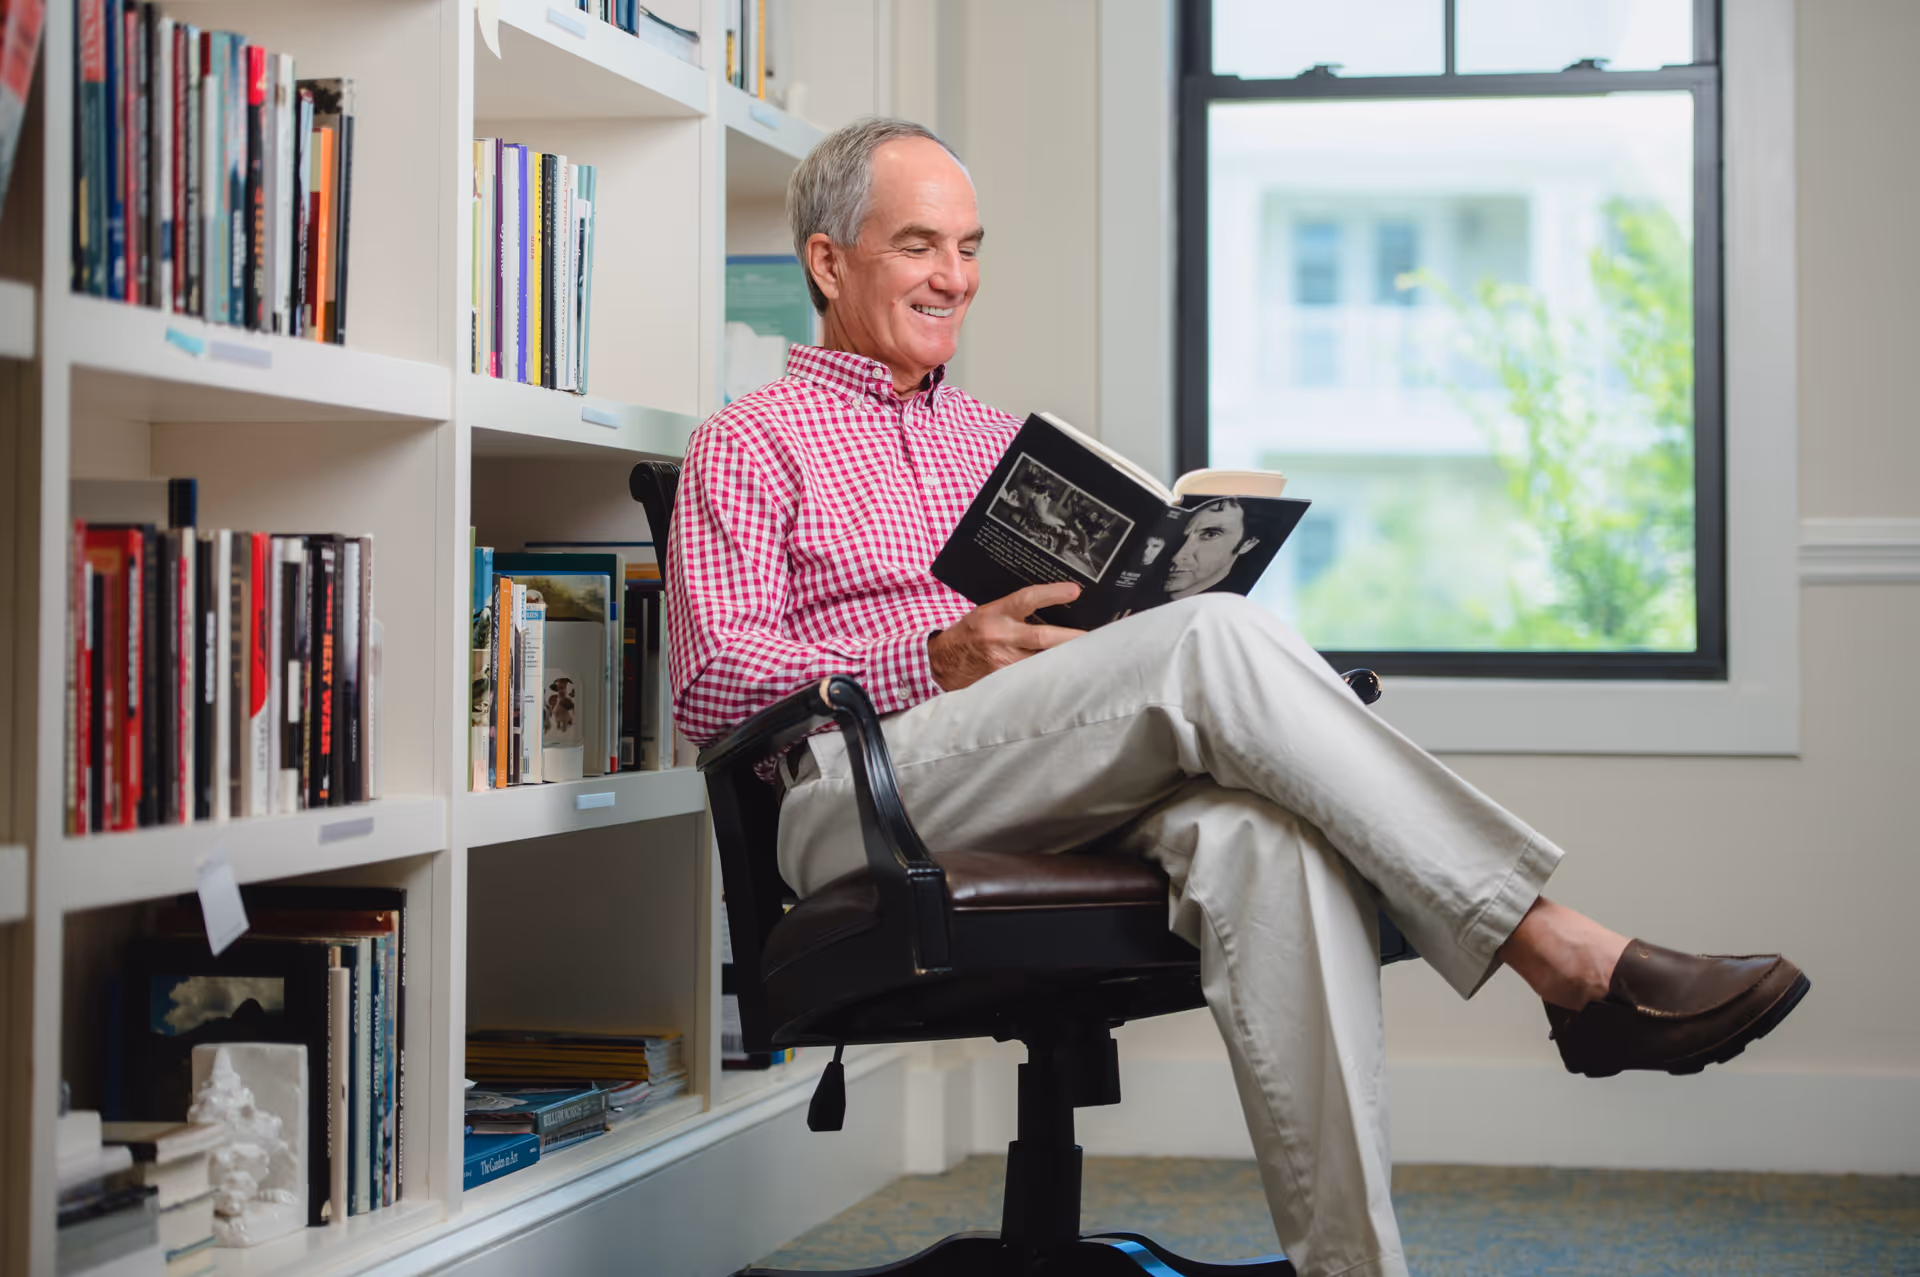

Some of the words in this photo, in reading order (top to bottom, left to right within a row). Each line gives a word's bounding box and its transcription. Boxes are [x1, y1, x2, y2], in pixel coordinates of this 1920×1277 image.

[480, 1159, 490, 1176] The
[489, 1153, 505, 1172] Garden
[504, 1152, 511, 1167] in
[510, 1150, 519, 1164] Art
